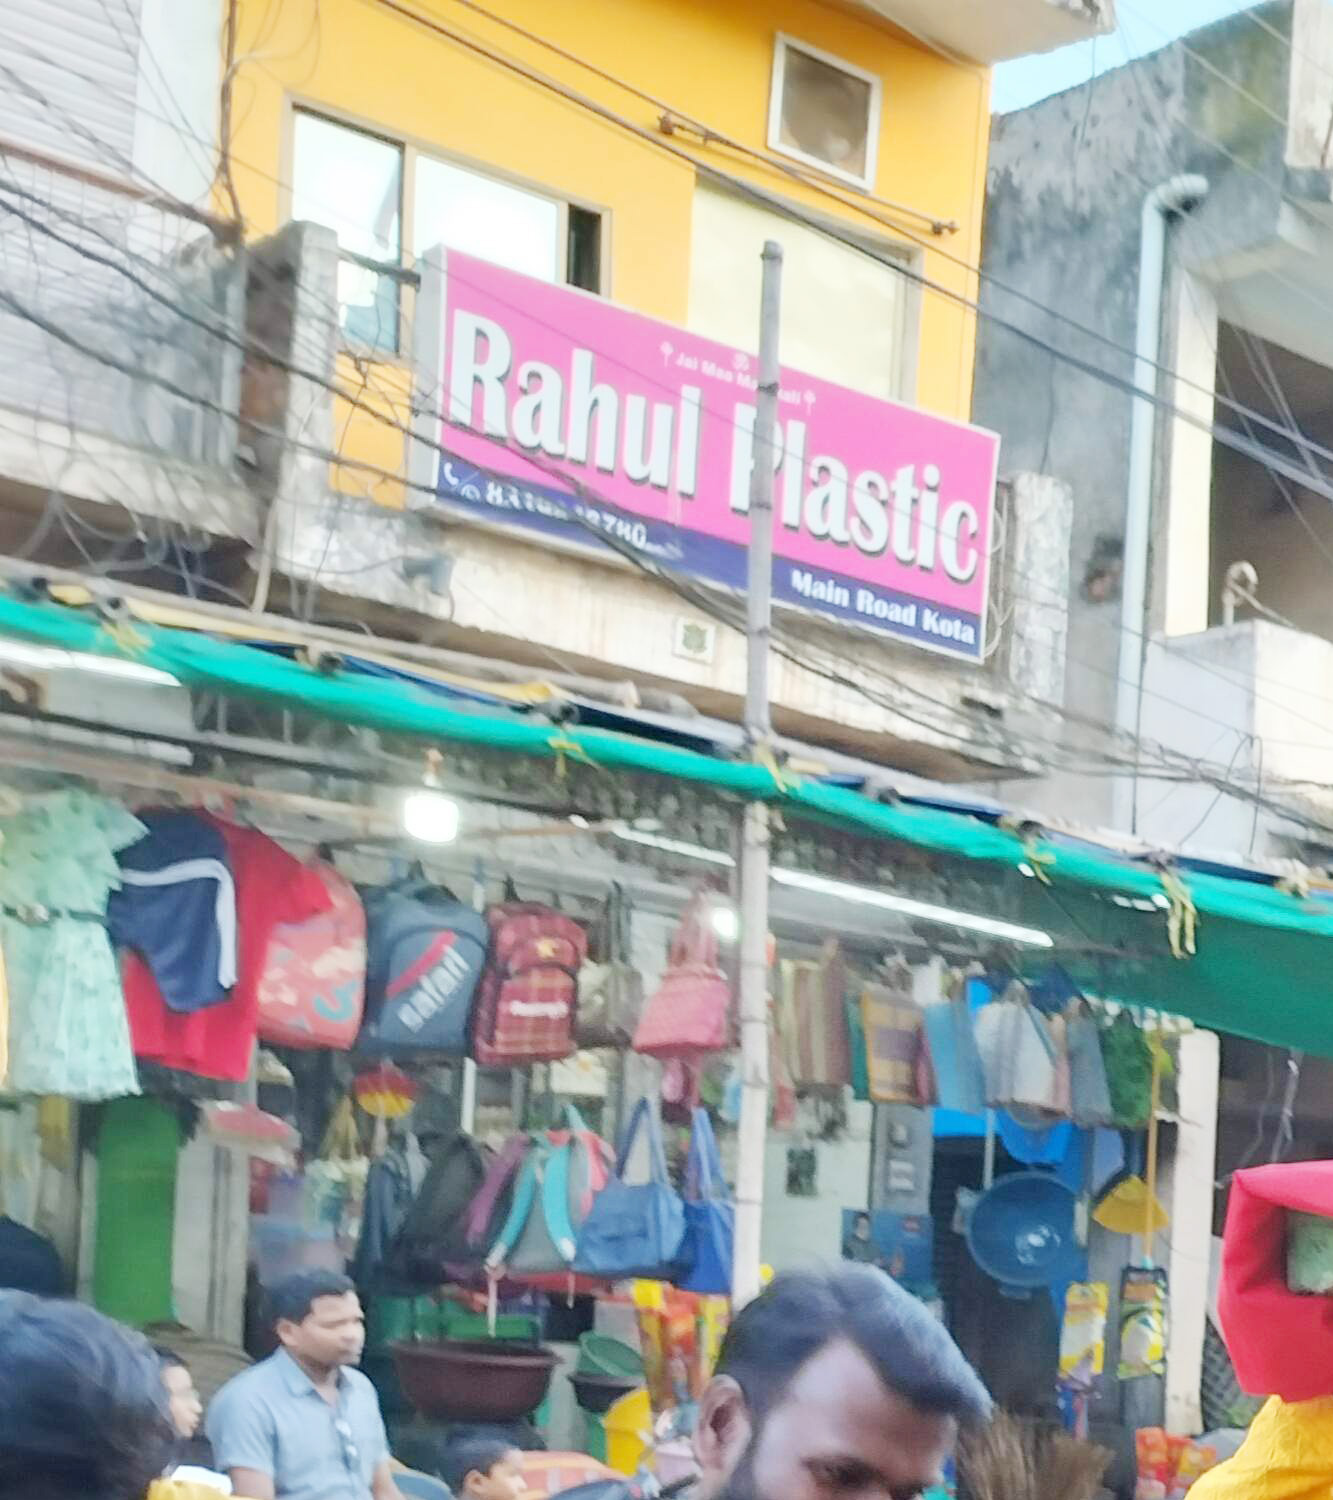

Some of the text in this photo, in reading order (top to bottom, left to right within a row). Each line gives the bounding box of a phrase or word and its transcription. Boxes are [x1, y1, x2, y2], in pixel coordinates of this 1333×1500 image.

[450, 308, 980, 583] Rahul Plastic
[791, 568, 976, 645] Main Road Kota
